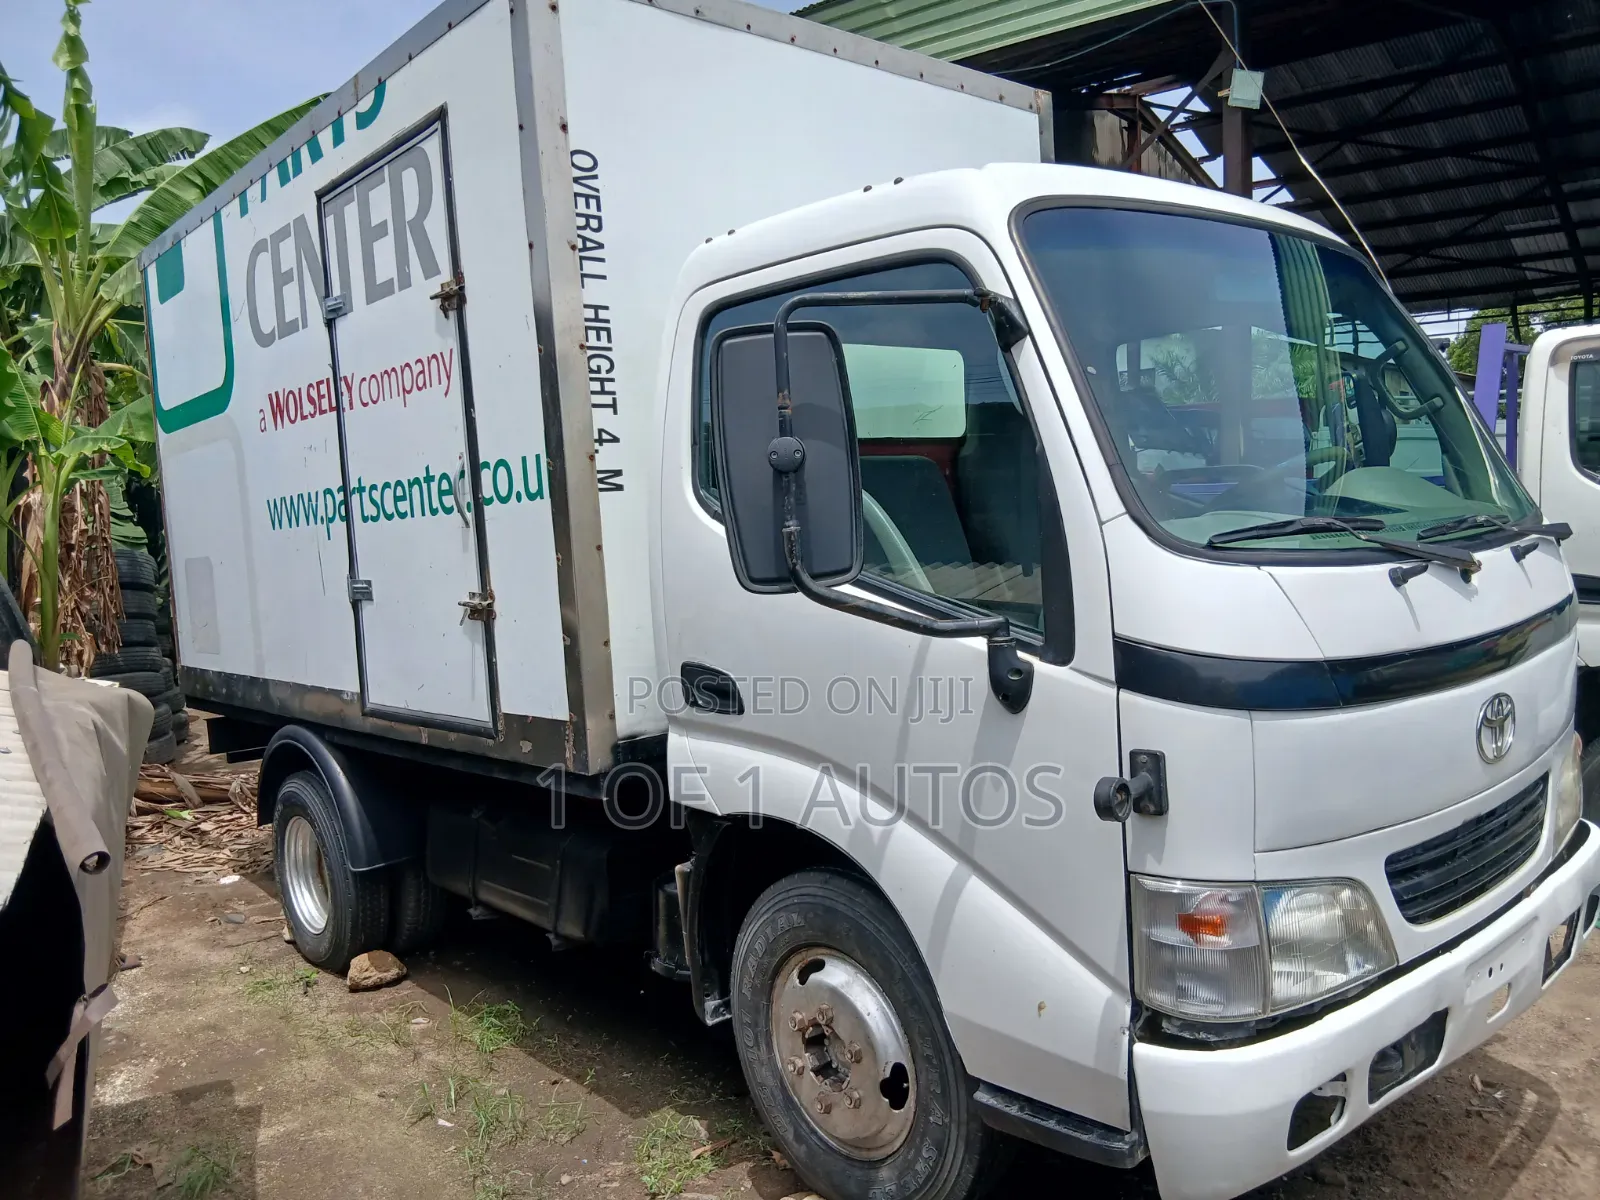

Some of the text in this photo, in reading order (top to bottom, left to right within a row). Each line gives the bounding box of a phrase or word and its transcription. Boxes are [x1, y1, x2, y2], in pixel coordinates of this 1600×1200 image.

[246, 146, 442, 348] CENTER
[570, 149, 608, 290] OVERALL
[259, 408, 267, 433] a
[359, 348, 453, 408] company
[583, 303, 619, 416] HEIGHT
[1570, 353, 1593, 361] TOYOTA
[596, 468, 625, 493] M
[741, 912, 806, 1001] RADIAL
